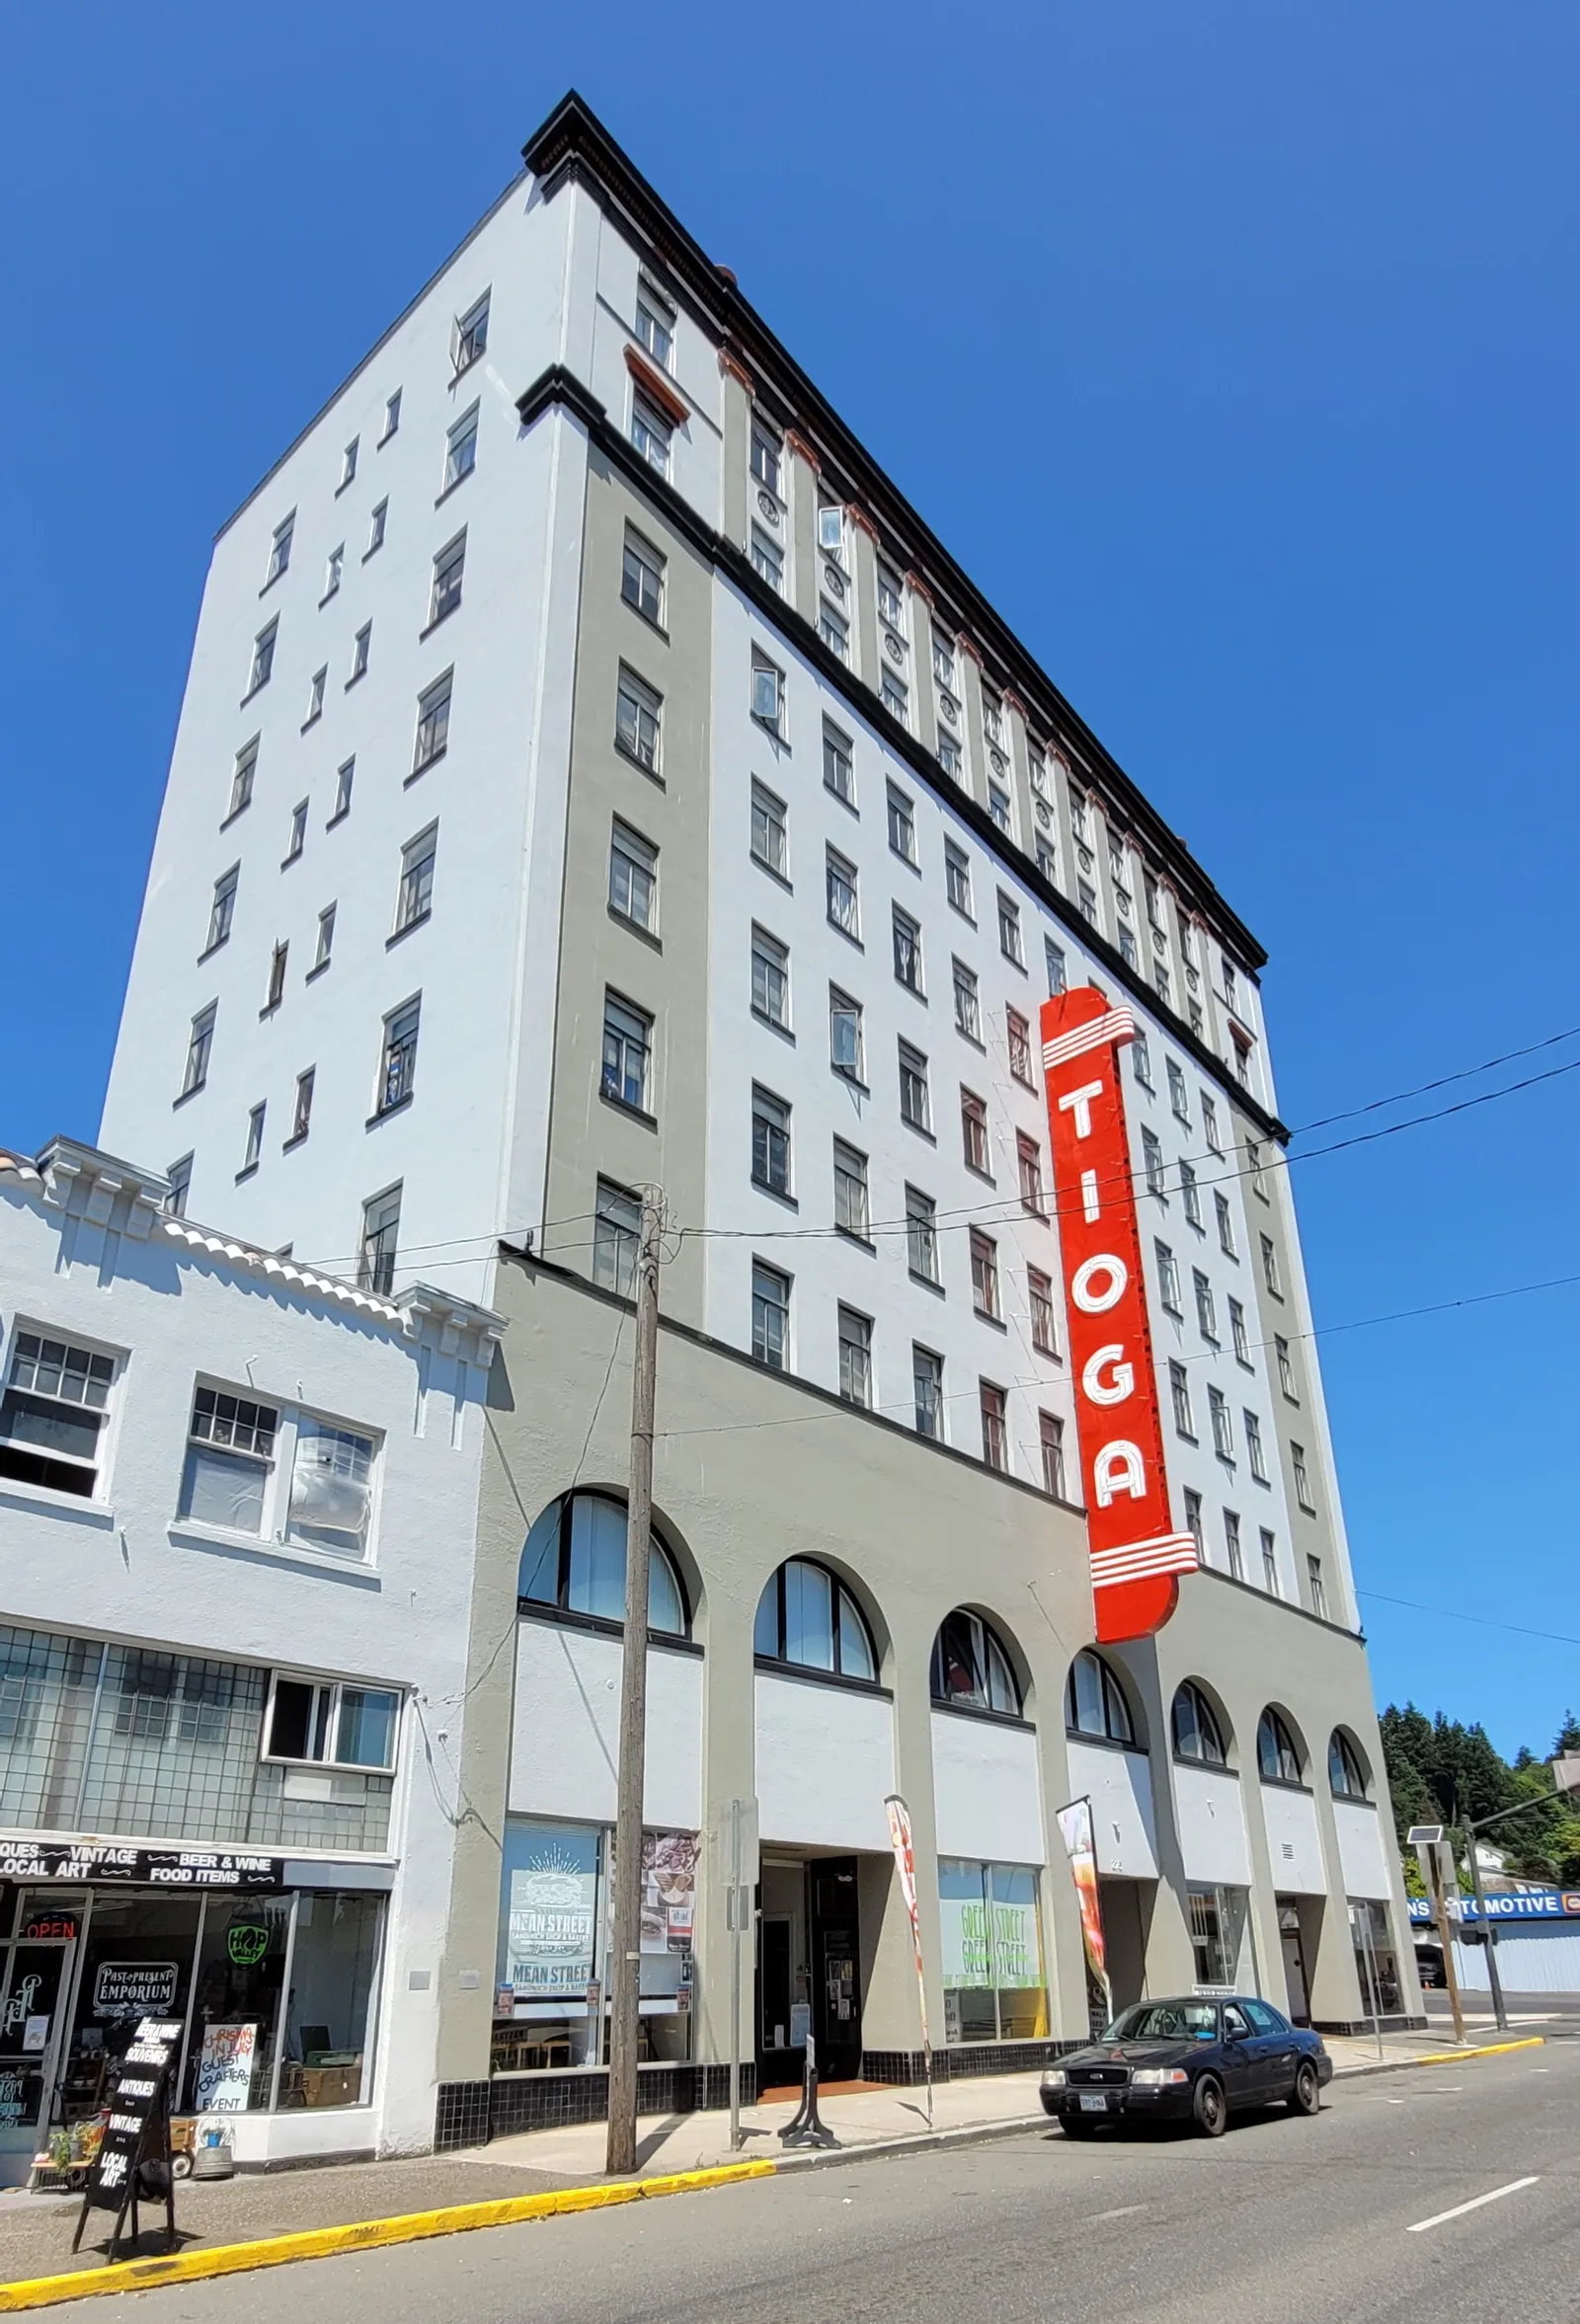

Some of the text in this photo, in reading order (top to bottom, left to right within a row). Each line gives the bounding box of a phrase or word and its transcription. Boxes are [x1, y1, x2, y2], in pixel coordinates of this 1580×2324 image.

[1059, 1080, 1146, 1510] TIOGA
[70, 1846, 138, 1865] VINTAGE
[179, 1853, 218, 1869] BEER
[220, 1856, 233, 1869] &
[235, 1857, 272, 1872] WINE
[0, 1858, 240, 1884] OCAL ART FOOD ITEMS
[27, 1921, 75, 1942] OPEN
[510, 1912, 592, 1935] MEAN STREET
[514, 1964, 548, 1983] MEAN
[100, 1984, 171, 2002] EMPORIUM
[201, 2053, 239, 2073] GUEST
[118, 2078, 155, 2097] ANTIQUES
[198, 2067, 250, 2093] CRAFTERS
[202, 2097, 241, 2110] EVENT
[109, 2113, 143, 2133] VINTAGE
[100, 2151, 127, 2173] LOCAL
[100, 2168, 119, 2189] ART
